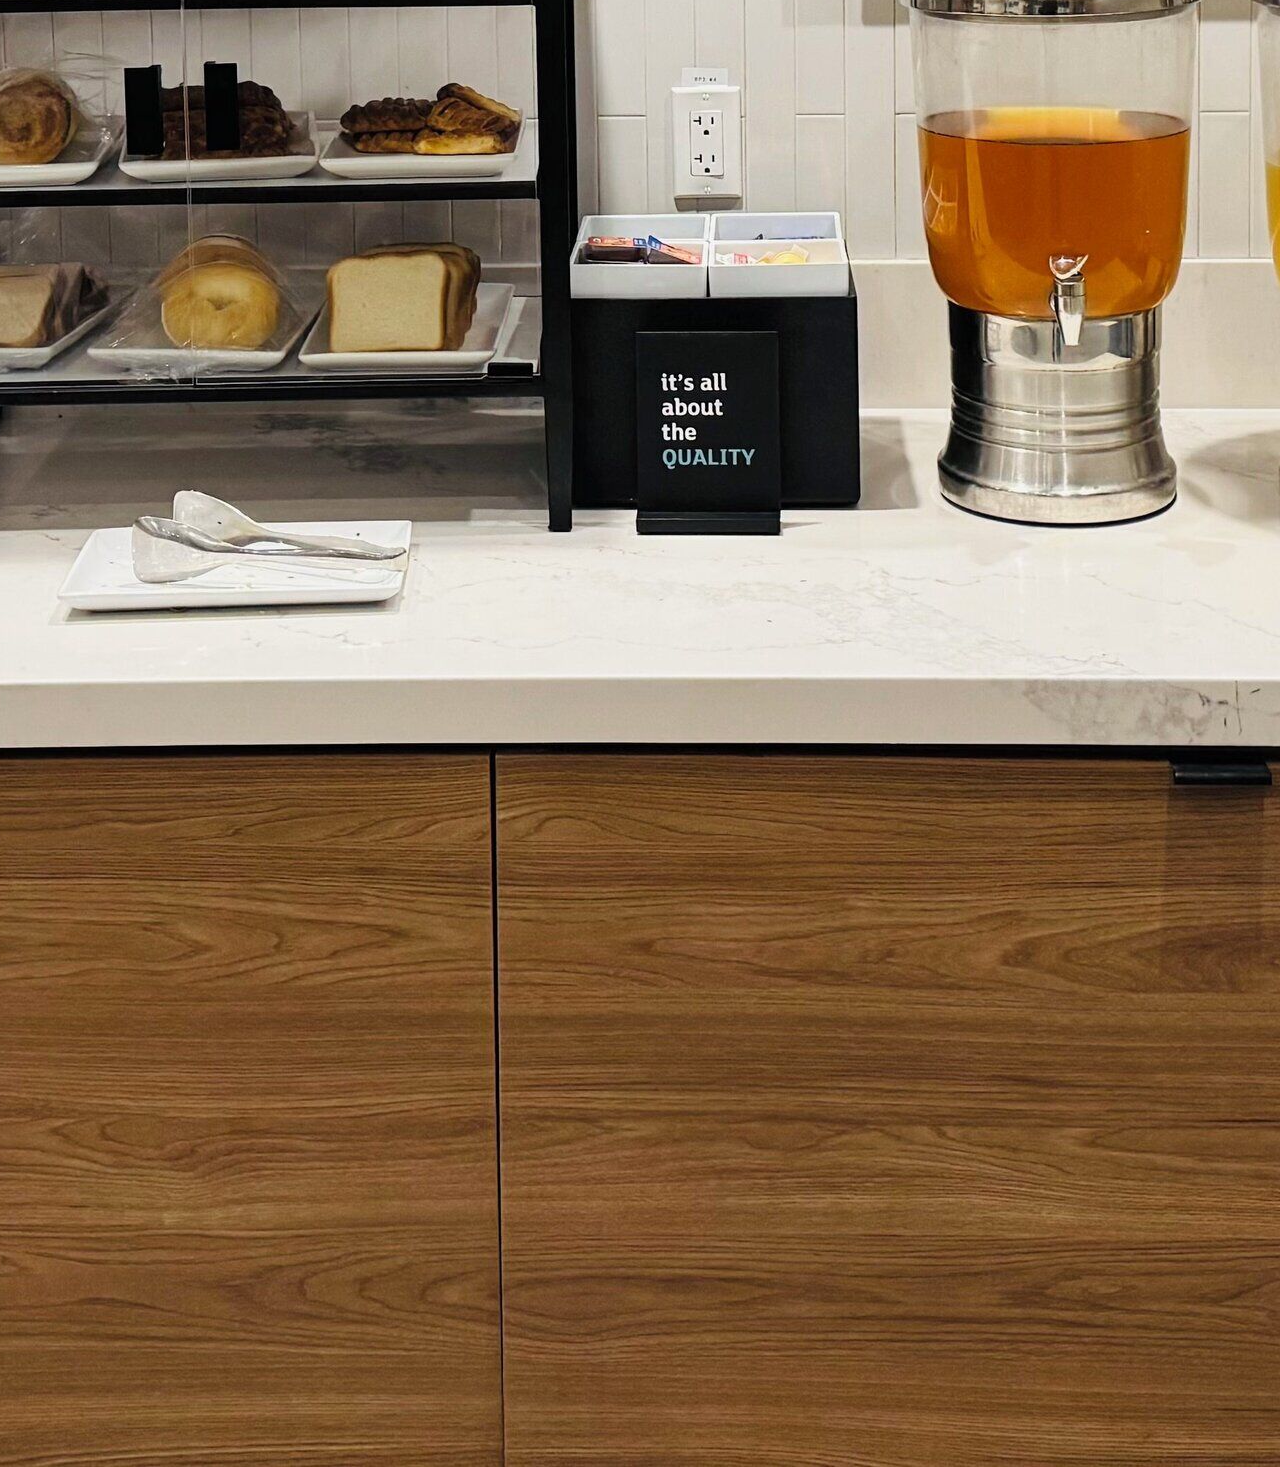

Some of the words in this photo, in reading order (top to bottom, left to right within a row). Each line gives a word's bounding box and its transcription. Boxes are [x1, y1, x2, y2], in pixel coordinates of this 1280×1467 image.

[661, 373, 694, 391] it's
[700, 372, 727, 391] all
[661, 397, 723, 416] about
[661, 422, 697, 441] the
[662, 449, 755, 469] QUALITY
